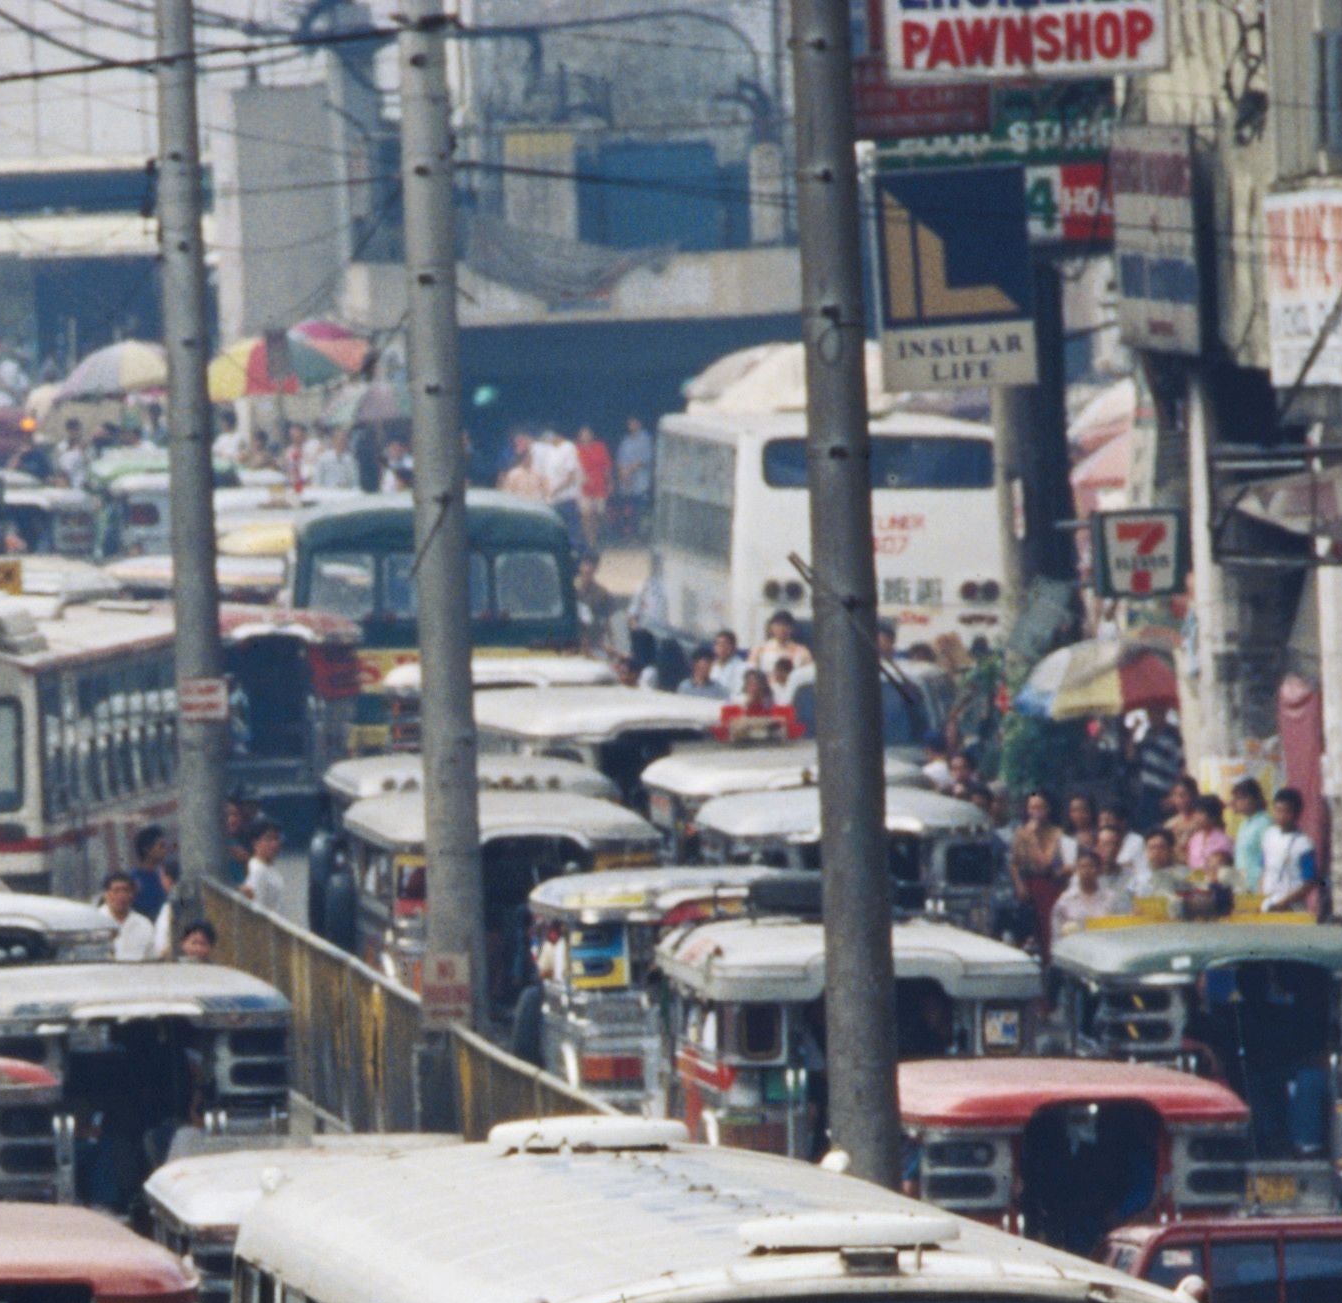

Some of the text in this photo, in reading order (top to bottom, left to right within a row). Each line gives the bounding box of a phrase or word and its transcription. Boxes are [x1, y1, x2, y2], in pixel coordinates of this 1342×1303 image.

[900, 8, 1154, 71] PAWNSHOP
[898, 334, 1023, 360] INSULAR
[931, 360, 993, 381] LIFE
